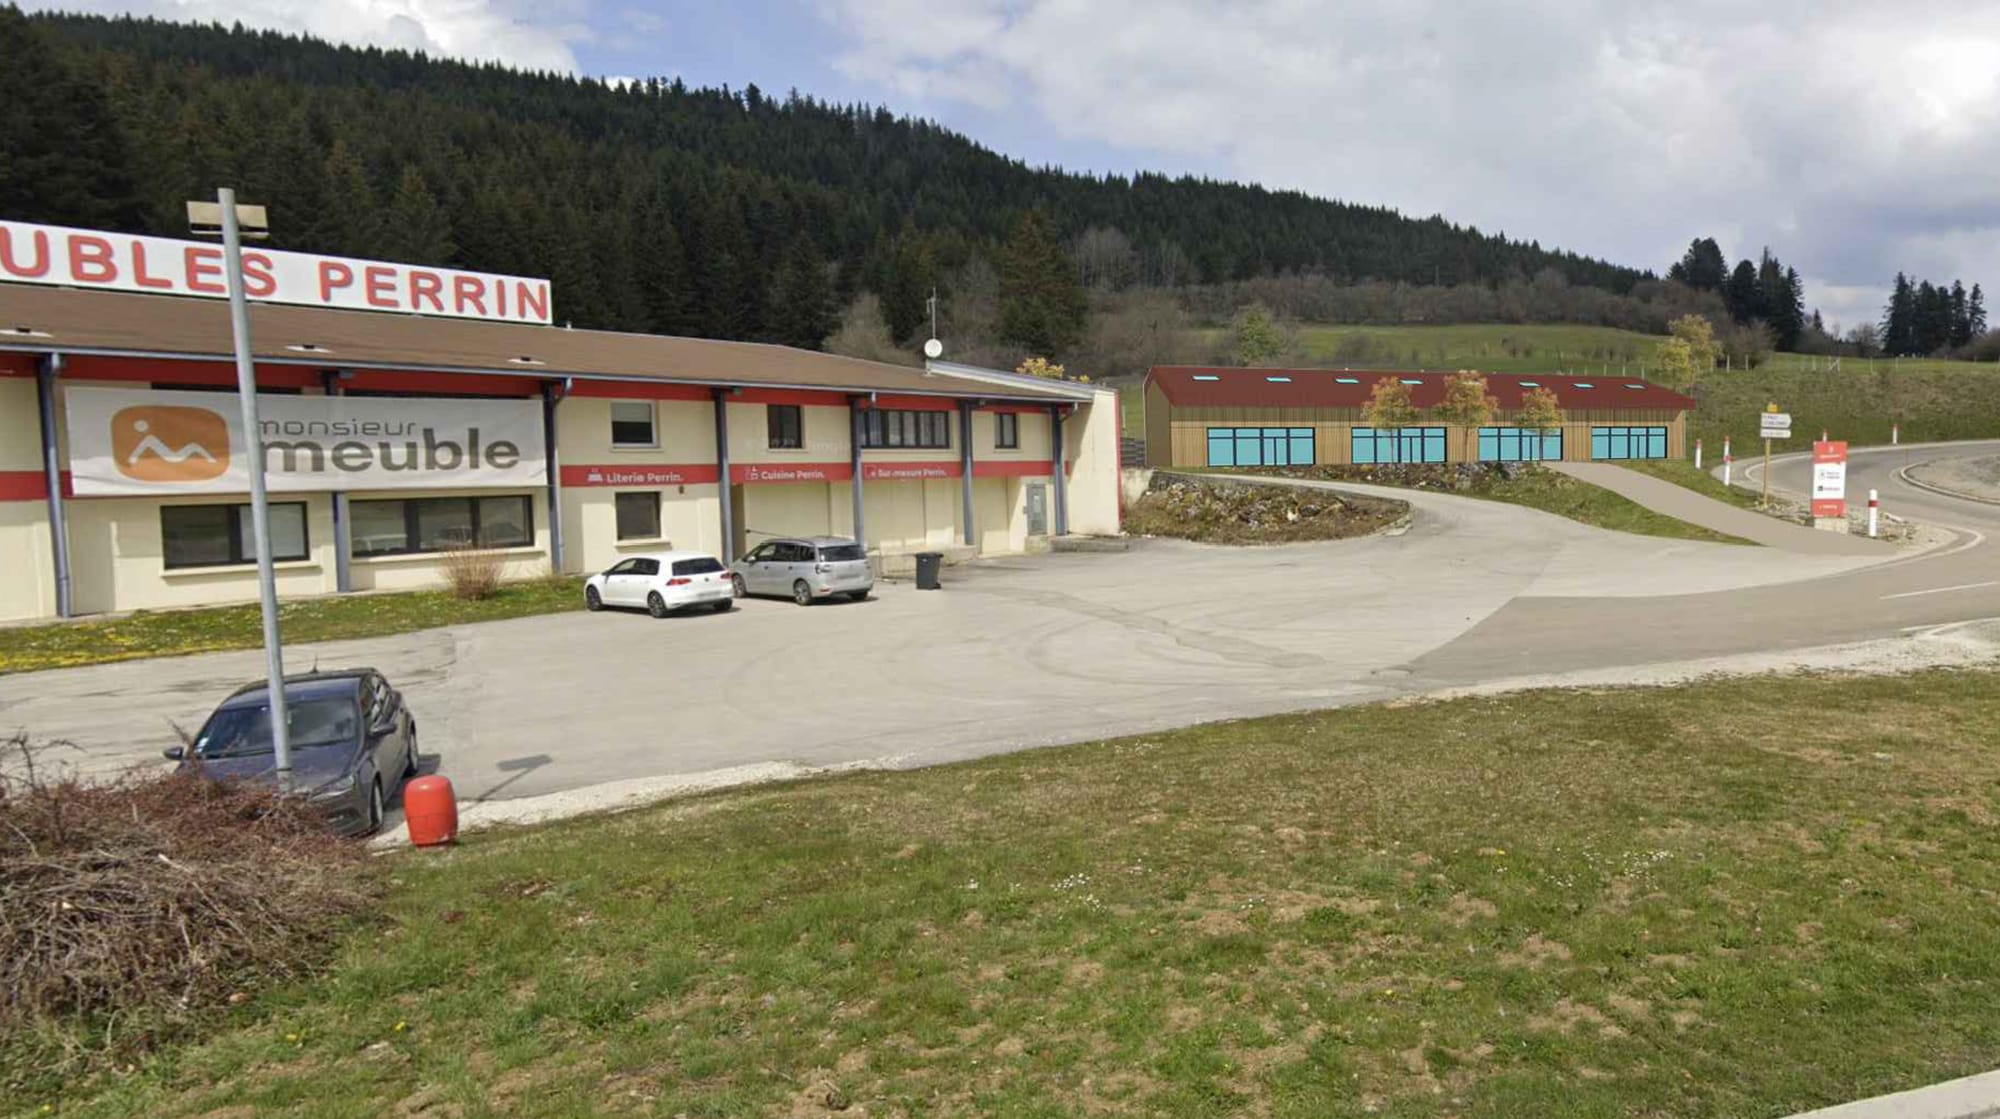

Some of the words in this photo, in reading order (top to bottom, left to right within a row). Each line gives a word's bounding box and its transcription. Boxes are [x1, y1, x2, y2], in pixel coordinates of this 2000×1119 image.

[0, 226, 277, 297] UBLES
[318, 261, 548, 321] PERRIN
[258, 418, 416, 436] monsieur
[261, 427, 520, 473] meuble
[606, 472, 645, 484] Literie
[761, 470, 795, 480] Cuisine
